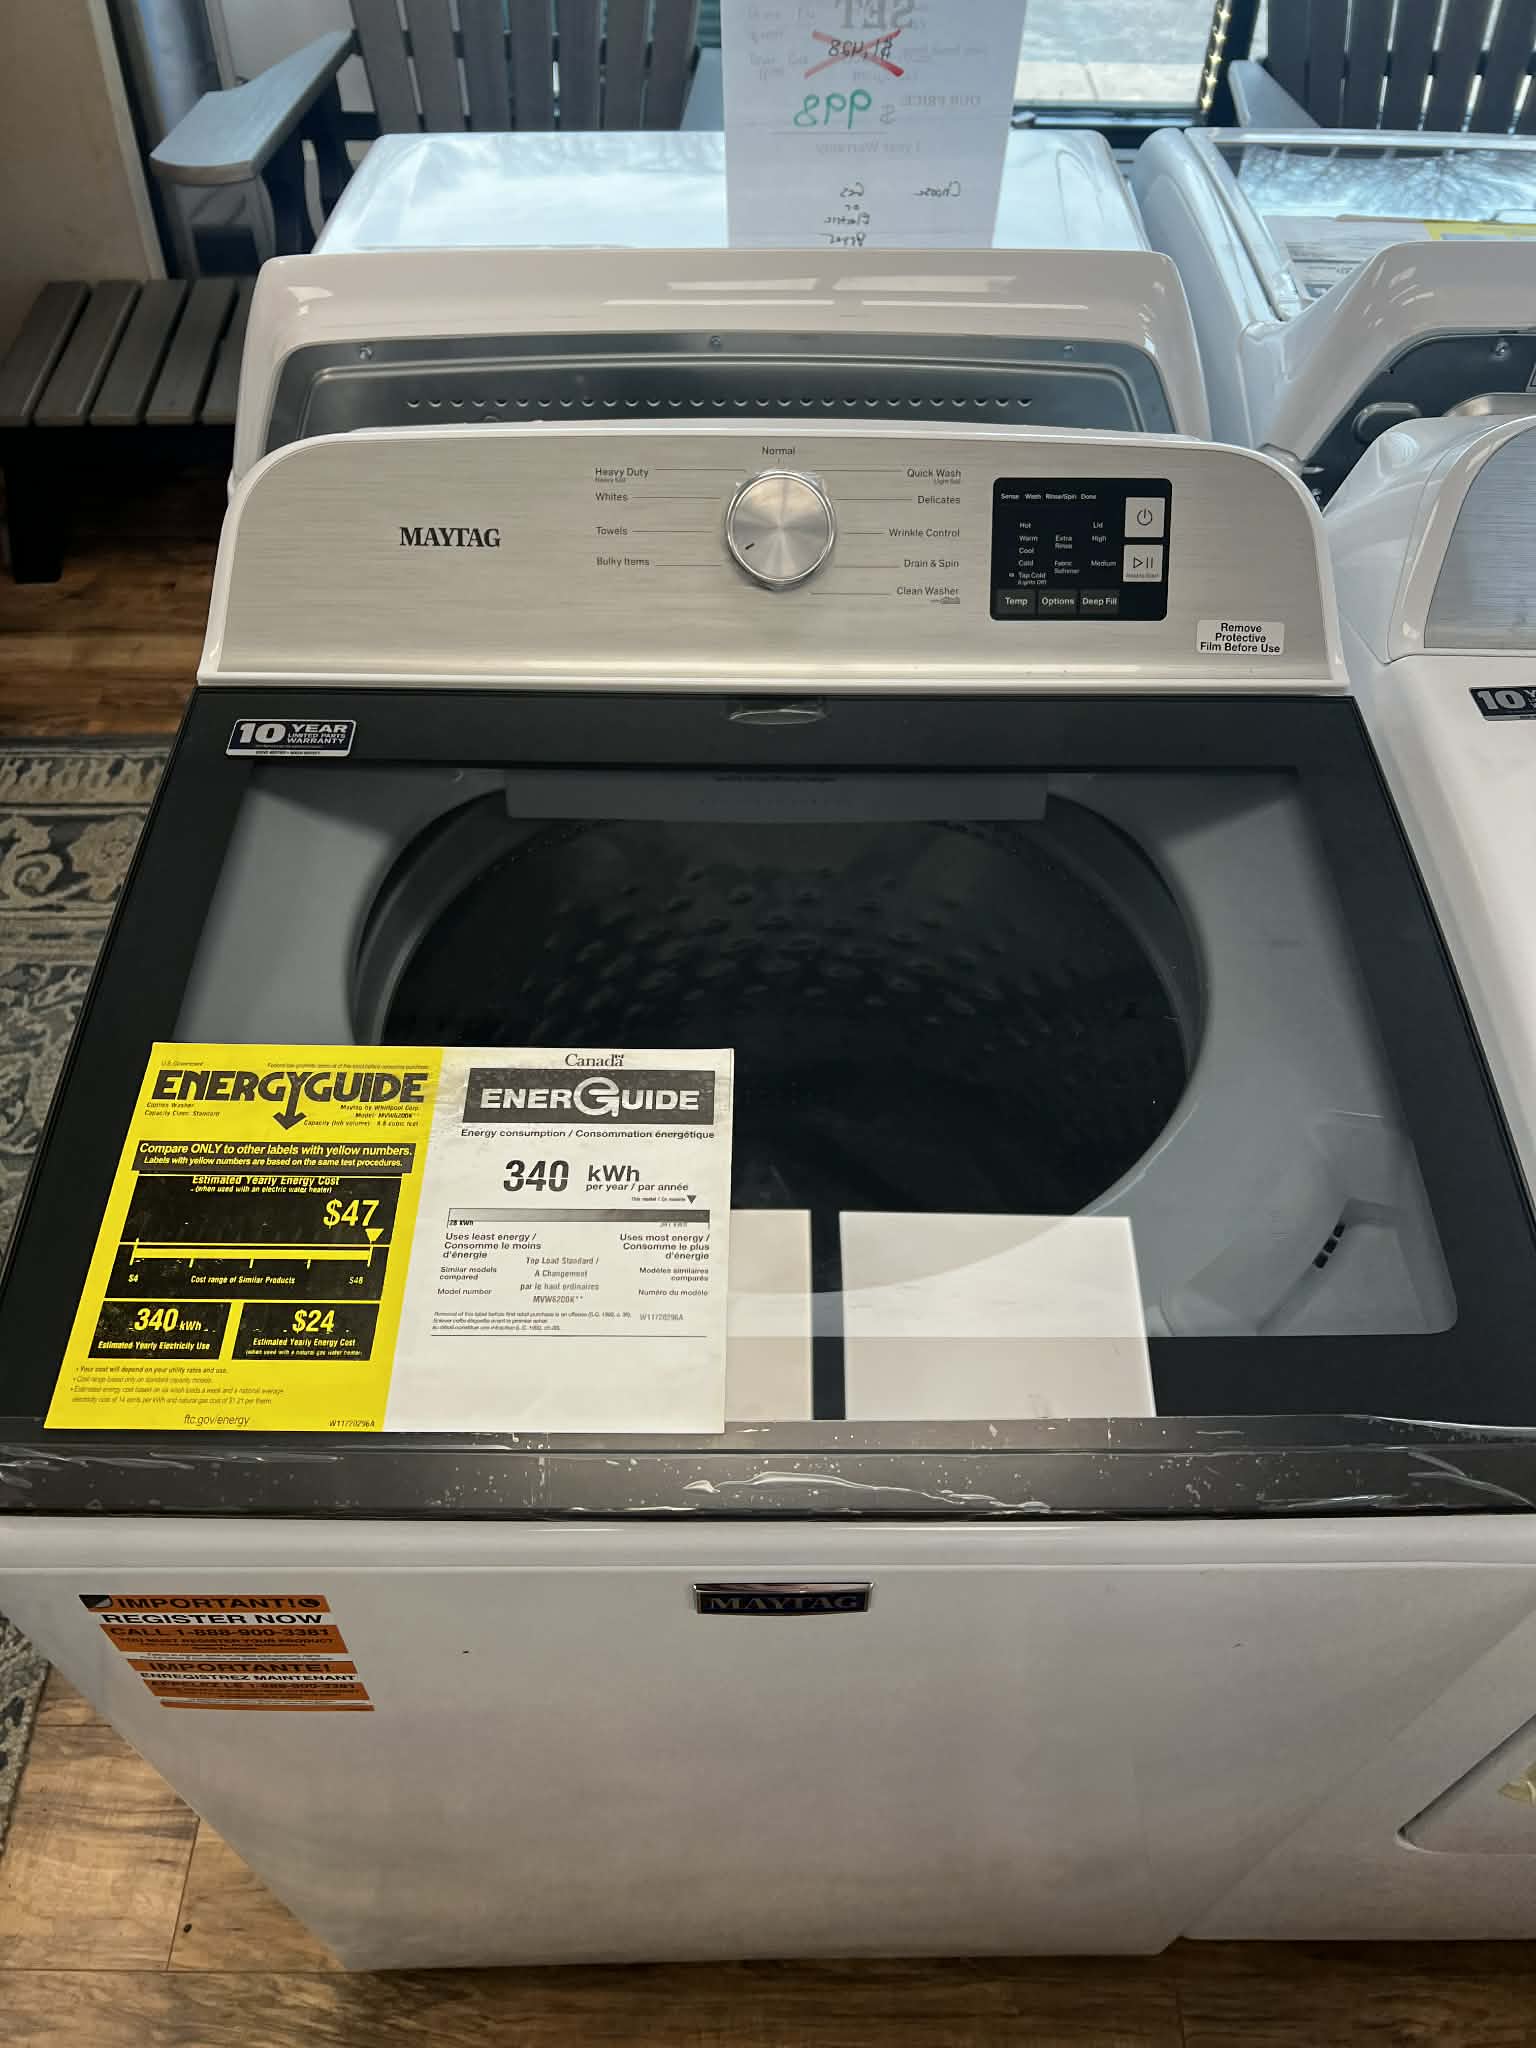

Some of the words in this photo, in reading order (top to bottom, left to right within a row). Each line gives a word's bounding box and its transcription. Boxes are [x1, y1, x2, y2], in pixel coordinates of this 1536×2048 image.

[762, 446, 796, 456] Normal
[595, 468, 624, 479] Heavy
[626, 468, 649, 479] Duty
[907, 469, 933, 478] Quick
[935, 469, 961, 478] Wash
[595, 492, 628, 502] Whites
[917, 495, 961, 505] Delicates
[596, 526, 628, 536] Towels
[889, 528, 924, 537] Wrinkle
[926, 528, 960, 538] Control
[400, 527, 501, 547] MAYTAG
[596, 557, 622, 567] Bulky
[623, 557, 650, 567] Items
[904, 559, 927, 568] Drain
[930, 559, 937, 568] &
[939, 559, 959, 570] Spin
[896, 586, 922, 596] Clean
[924, 586, 959, 596] Washer
[1005, 598, 1028, 606] Temp
[1042, 598, 1074, 606] Options
[1083, 598, 1104, 606] Deep
[1221, 623, 1262, 632] Remove
[1215, 633, 1266, 643] Protective
[1200, 642, 1221, 651] Film
[1225, 643, 1257, 652] Before
[1261, 644, 1280, 652] Use
[1478, 691, 1526, 709] 10
[240, 723, 286, 743] 10
[292, 724, 348, 732] YEAR
[565, 1053, 624, 1067] Canada
[152, 1070, 429, 1108] ENERGYGUIDE
[479, 1076, 700, 1117] ENERGUIDE
[461, 1128, 497, 1138] Energy
[500, 1129, 566, 1138] consumption
[575, 1129, 653, 1139] Consommation
[655, 1130, 715, 1140] énergétique
[140, 1143, 188, 1155] Compare
[191, 1144, 223, 1154] ONLY
[224, 1144, 234, 1154] to
[237, 1144, 265, 1154] other
[267, 1145, 298, 1155] labels
[301, 1145, 324, 1155] with
[325, 1145, 359, 1157] yellow
[362, 1146, 412, 1156] numbers.
[188, 1157, 215, 1166] yellow
[216, 1157, 250, 1165] numbers
[266, 1158, 290, 1166] based
[303, 1158, 316, 1166] the
[357, 1159, 402, 1167] procedures.
[503, 1159, 569, 1192] 340
[588, 1165, 640, 1183] kWh
[192, 1176, 241, 1184] Estimated
[246, 1176, 277, 1186] Yearly
[280, 1177, 314, 1186] Energy
[318, 1177, 340, 1185] Cost
[586, 1183, 603, 1192] per
[606, 1183, 628, 1192] year
[638, 1183, 655, 1192] par
[658, 1183, 688, 1192] année
[323, 1199, 380, 1229] $47
[497, 1233, 530, 1242] energy
[672, 1234, 703, 1243] energy
[623, 1242, 676, 1250] Consomme
[690, 1243, 710, 1251] plus
[442, 1251, 487, 1260] d'énergie
[666, 1252, 709, 1260] d'énergie
[542, 1257, 560, 1265] Load
[562, 1257, 594, 1265] Standard
[208, 1276, 228, 1284] range
[238, 1276, 263, 1284] Similar
[265, 1276, 295, 1284] Products
[520, 1283, 532, 1291] par
[544, 1282, 560, 1290] haut
[562, 1283, 600, 1291] ordinaires
[134, 1308, 179, 1332] 340
[179, 1321, 201, 1330] kWh
[292, 1309, 335, 1334] $24
[98, 1341, 134, 1349] Estimated
[135, 1342, 157, 1351] Yearly
[159, 1342, 195, 1351] Electricity
[253, 1338, 288, 1346] Estimated
[290, 1338, 312, 1348] Yearly
[313, 1338, 338, 1348] Energy
[184, 1414, 250, 1427] ftc.gov/energy
[711, 1597, 857, 1609] MAYTAG
[101, 1614, 247, 1624] REGISTER
[250, 1614, 323, 1624] NOW
[110, 1628, 170, 1636] CALL
